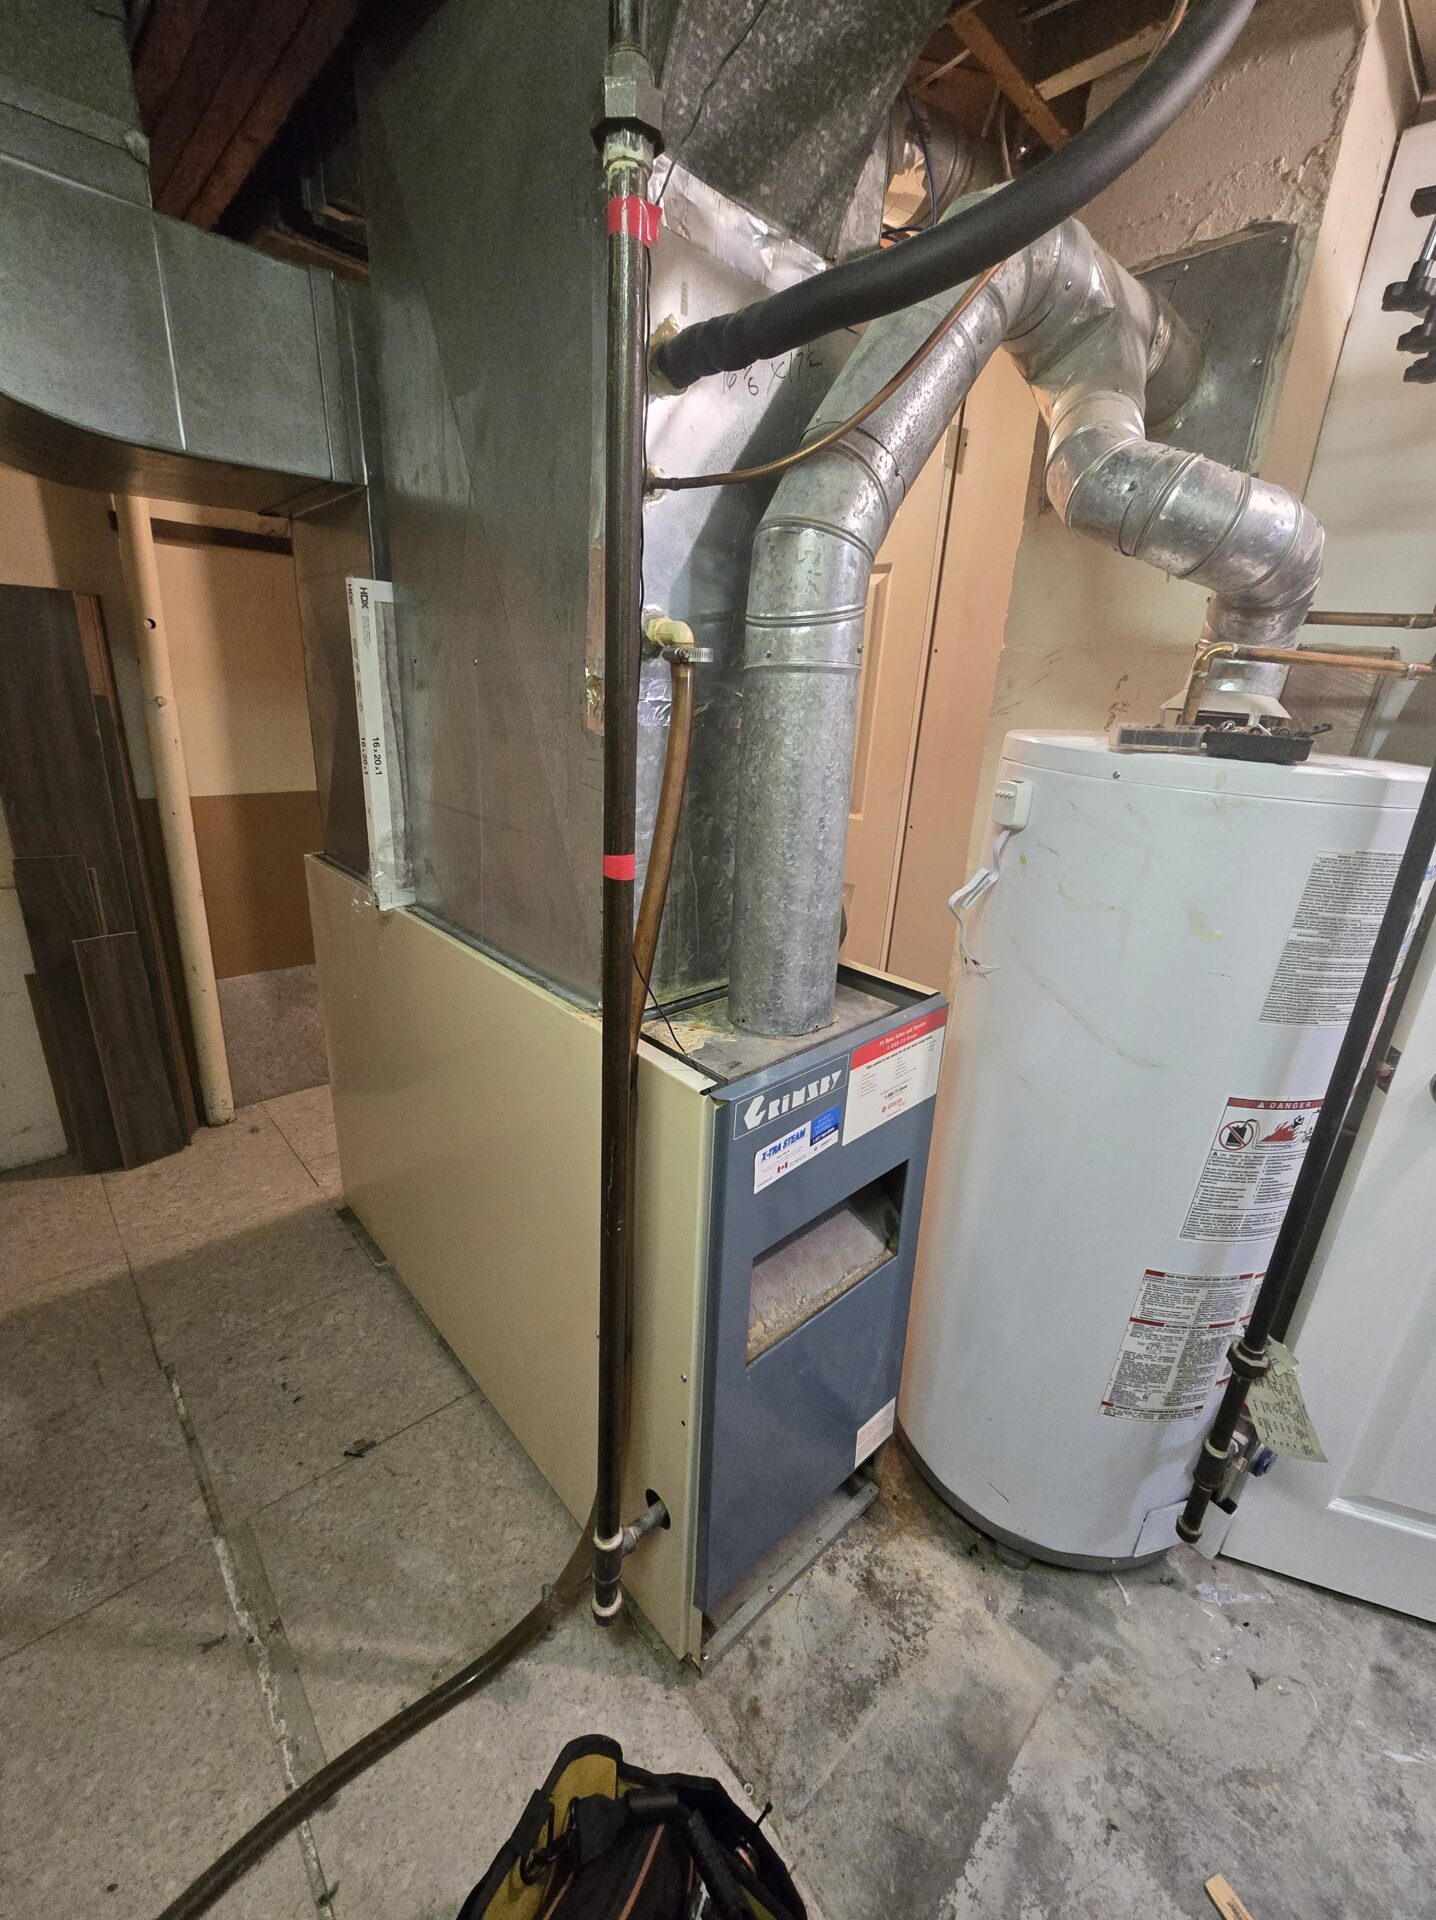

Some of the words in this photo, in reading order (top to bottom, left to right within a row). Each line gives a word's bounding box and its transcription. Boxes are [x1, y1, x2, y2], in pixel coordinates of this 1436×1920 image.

[359, 586, 369, 610] HDX
[1269, 1101, 1312, 1109] DANGER
[761, 1142, 782, 1162] X-TRA
[782, 1127, 807, 1149] STEAM
